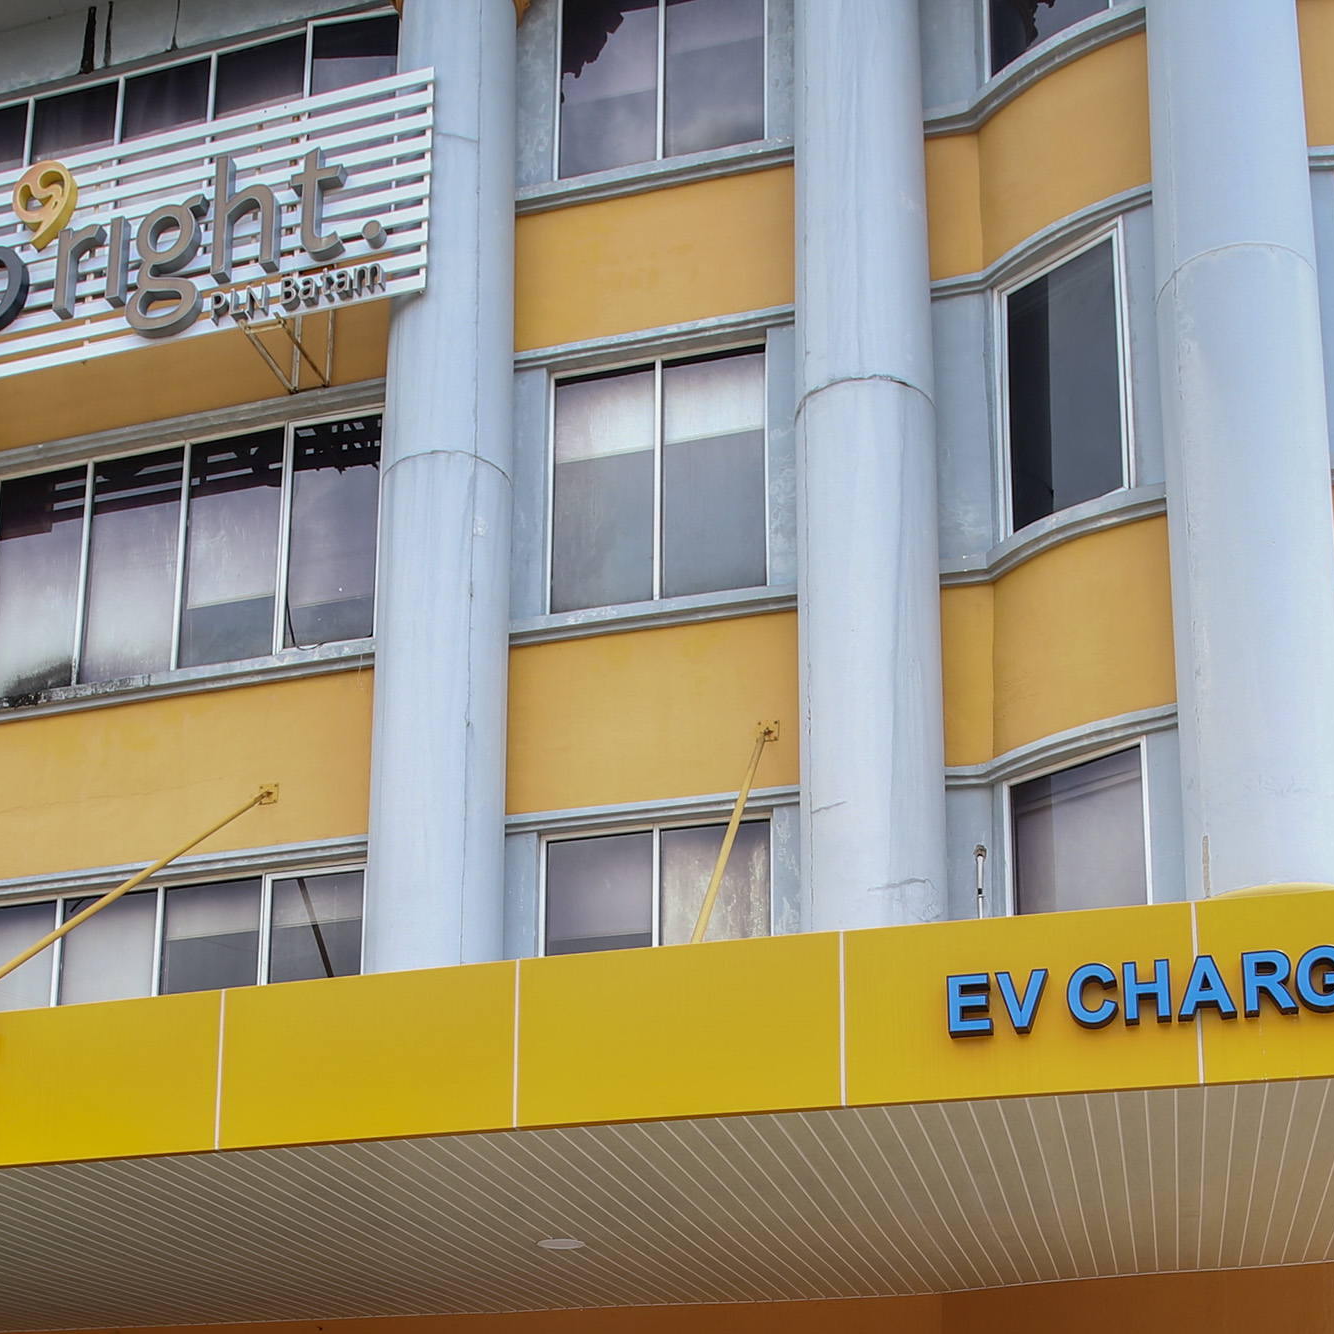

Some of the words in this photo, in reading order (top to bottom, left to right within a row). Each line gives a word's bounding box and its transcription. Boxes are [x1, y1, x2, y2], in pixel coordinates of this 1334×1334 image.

[210, 281, 271, 326] PLN
[278, 259, 387, 312] Batam
[948, 968, 1048, 1038] EV
